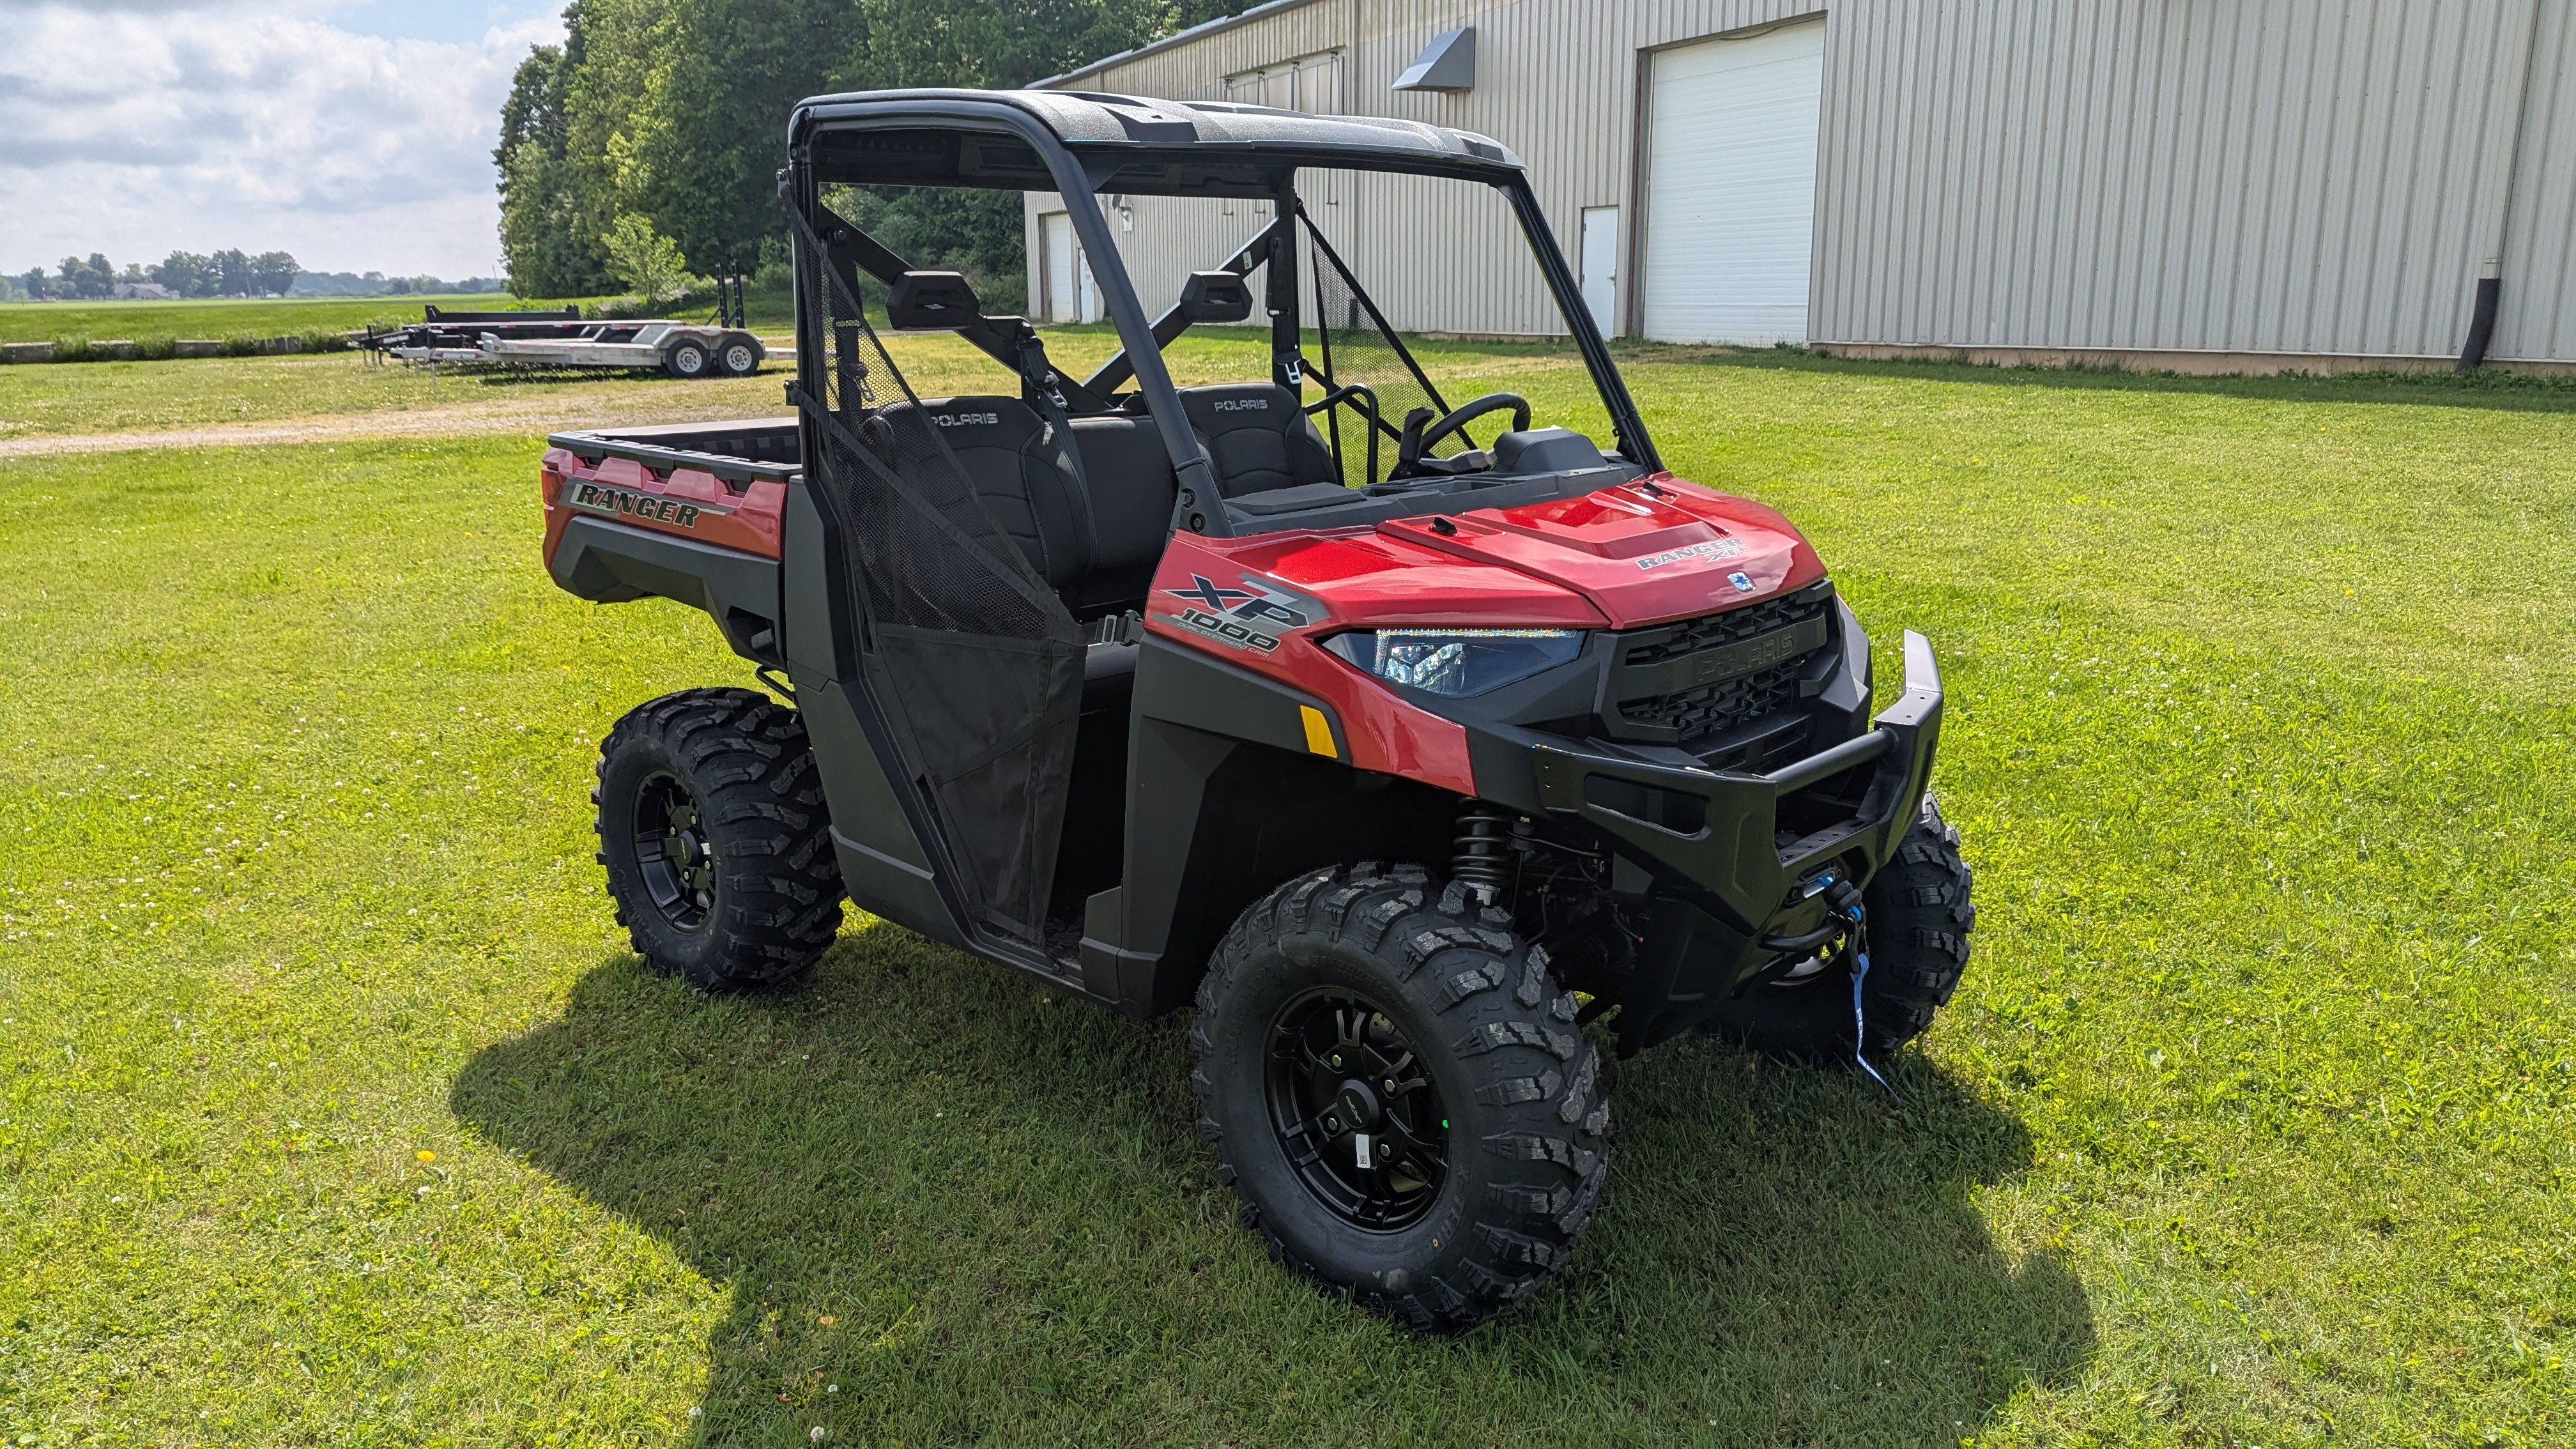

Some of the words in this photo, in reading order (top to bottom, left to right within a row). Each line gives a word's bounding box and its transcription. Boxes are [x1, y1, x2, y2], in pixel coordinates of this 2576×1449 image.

[1214, 399, 1268, 413] POLARIS
[575, 483, 701, 529] RANGER
[1636, 538, 1748, 570] RANGER
[1706, 548, 1748, 564] XP
[1159, 572, 1310, 629] XP
[1177, 622, 1199, 632] DUAL
[1200, 630, 1248, 650] OVERHEAD
[1248, 648, 1270, 657] CAM
[1181, 607, 1282, 653] 1000
[1697, 631, 1794, 682] POLARIS
